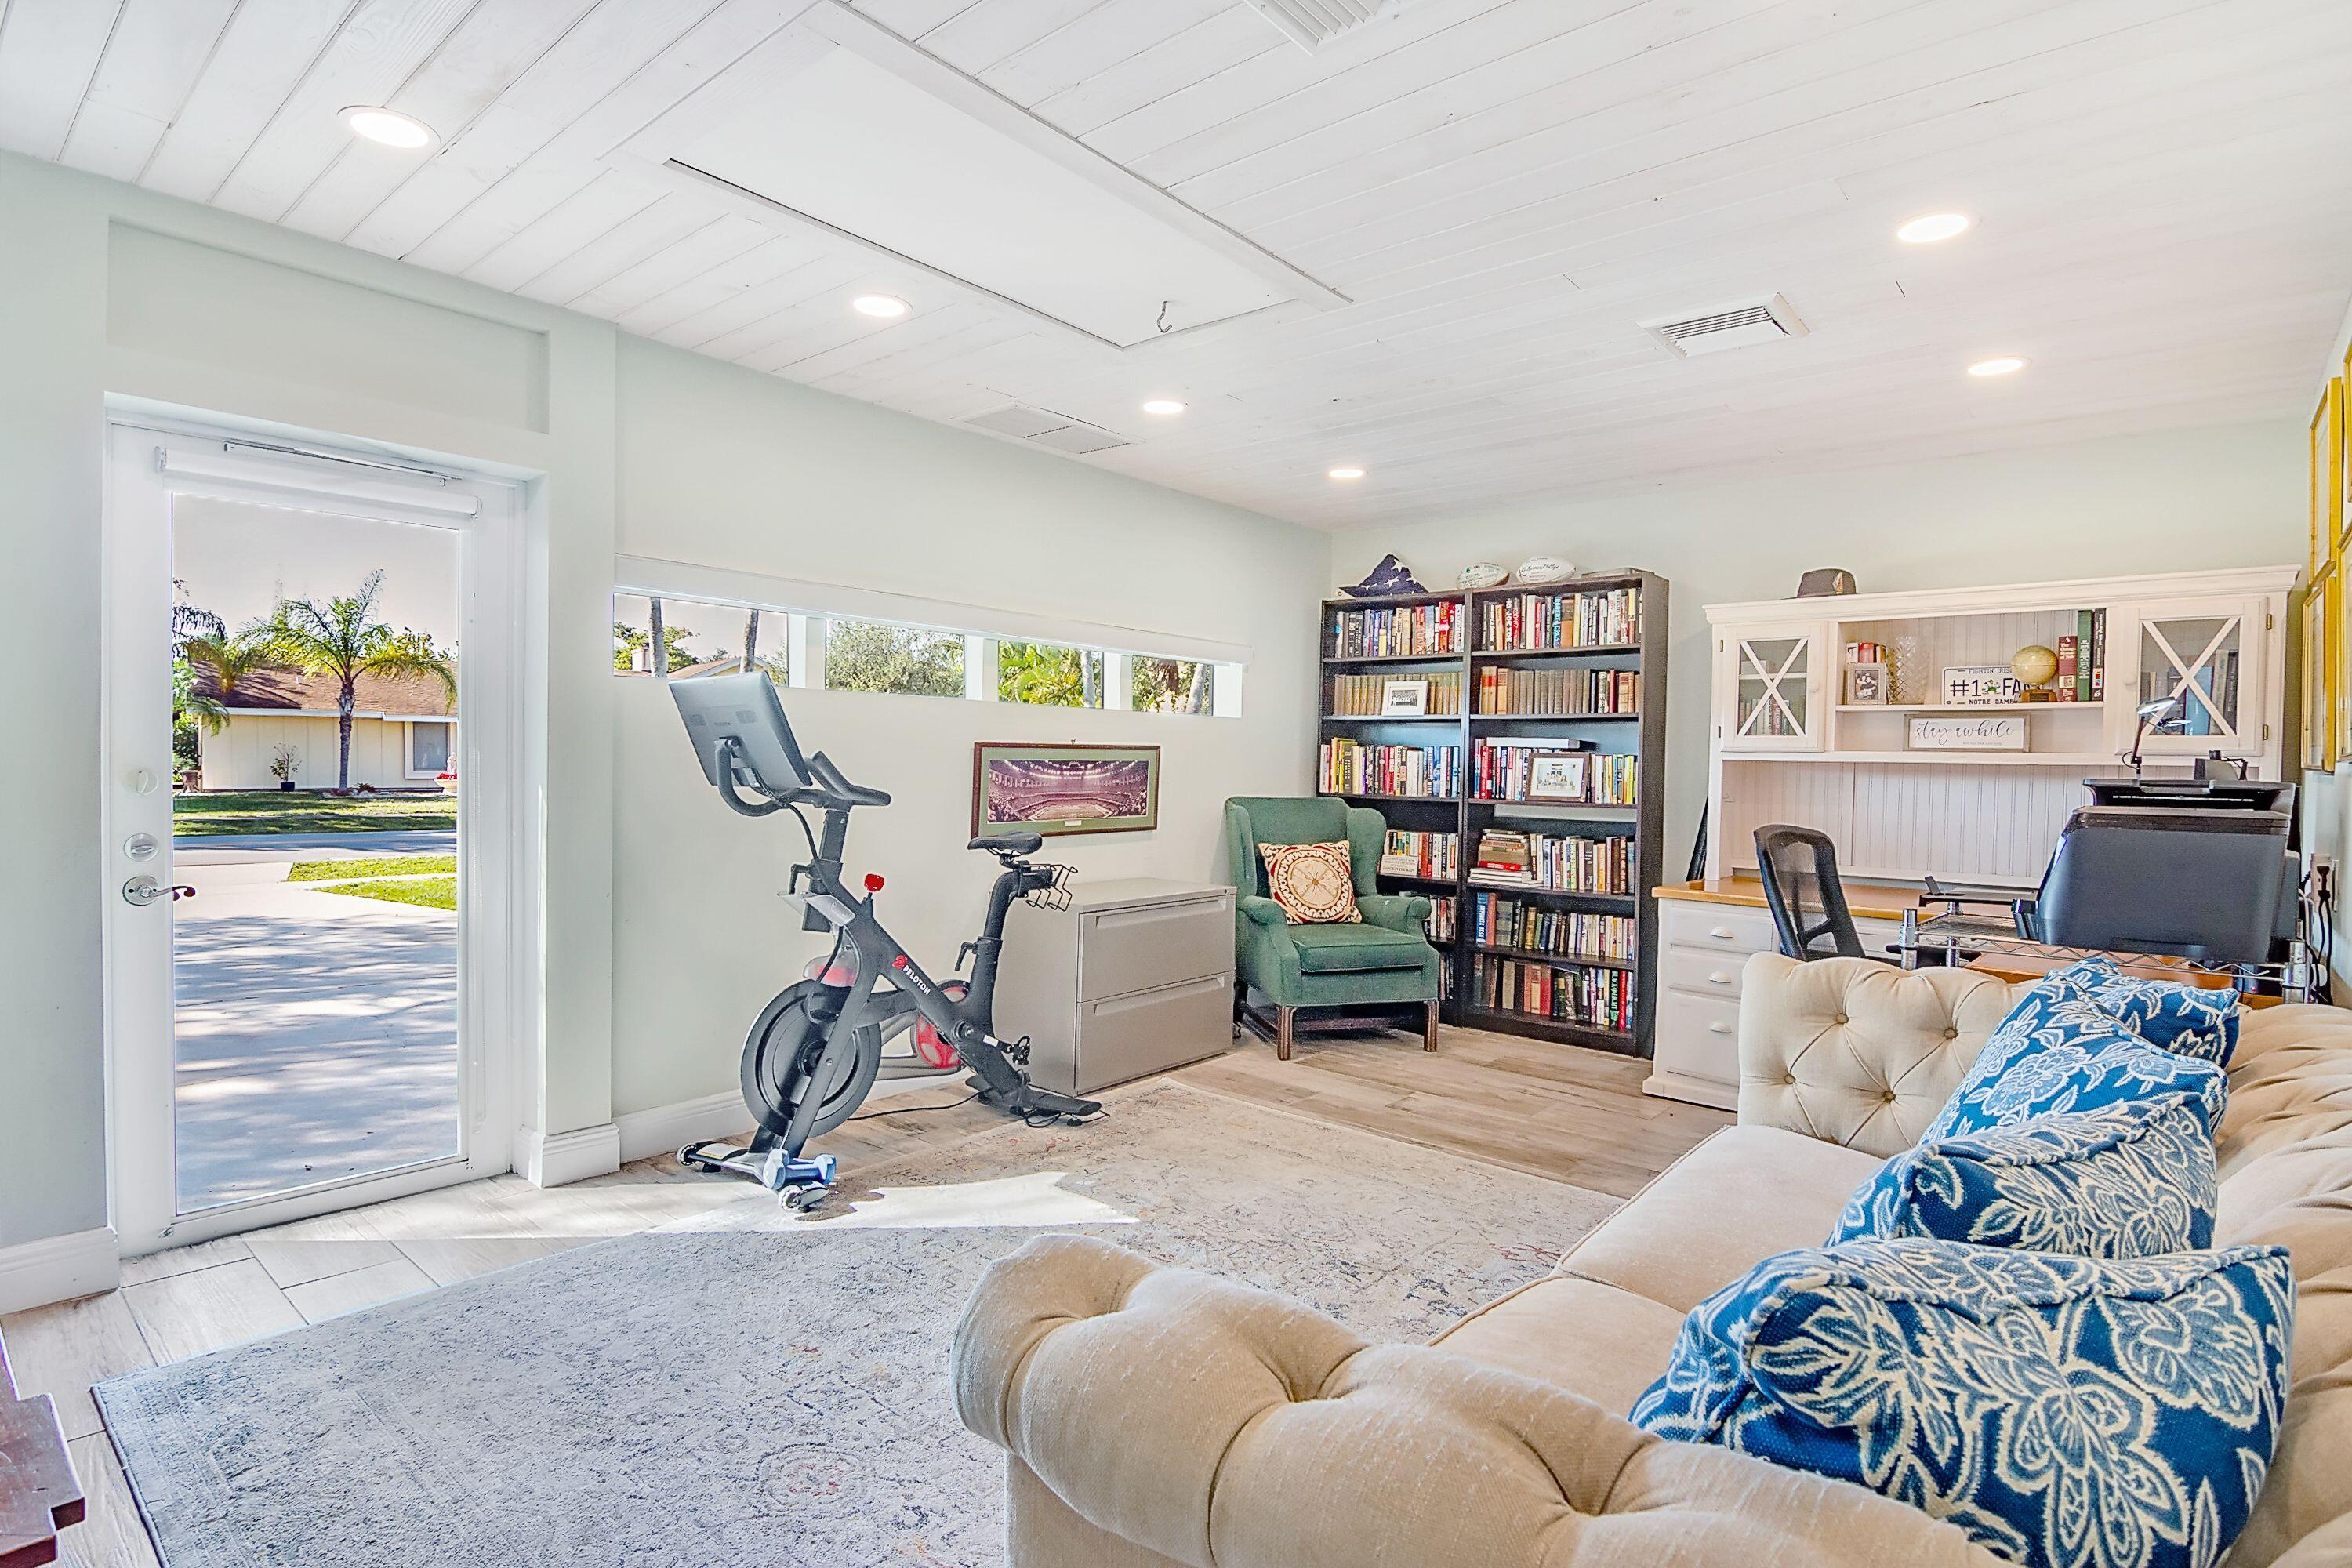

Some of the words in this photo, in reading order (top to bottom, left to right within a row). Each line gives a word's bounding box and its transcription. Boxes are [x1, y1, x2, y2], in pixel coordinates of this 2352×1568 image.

[1950, 679, 1981, 696] #1
[1915, 720, 1950, 745] stay
[1955, 719, 2014, 737] awhile
[903, 964, 931, 995] PELOTON
